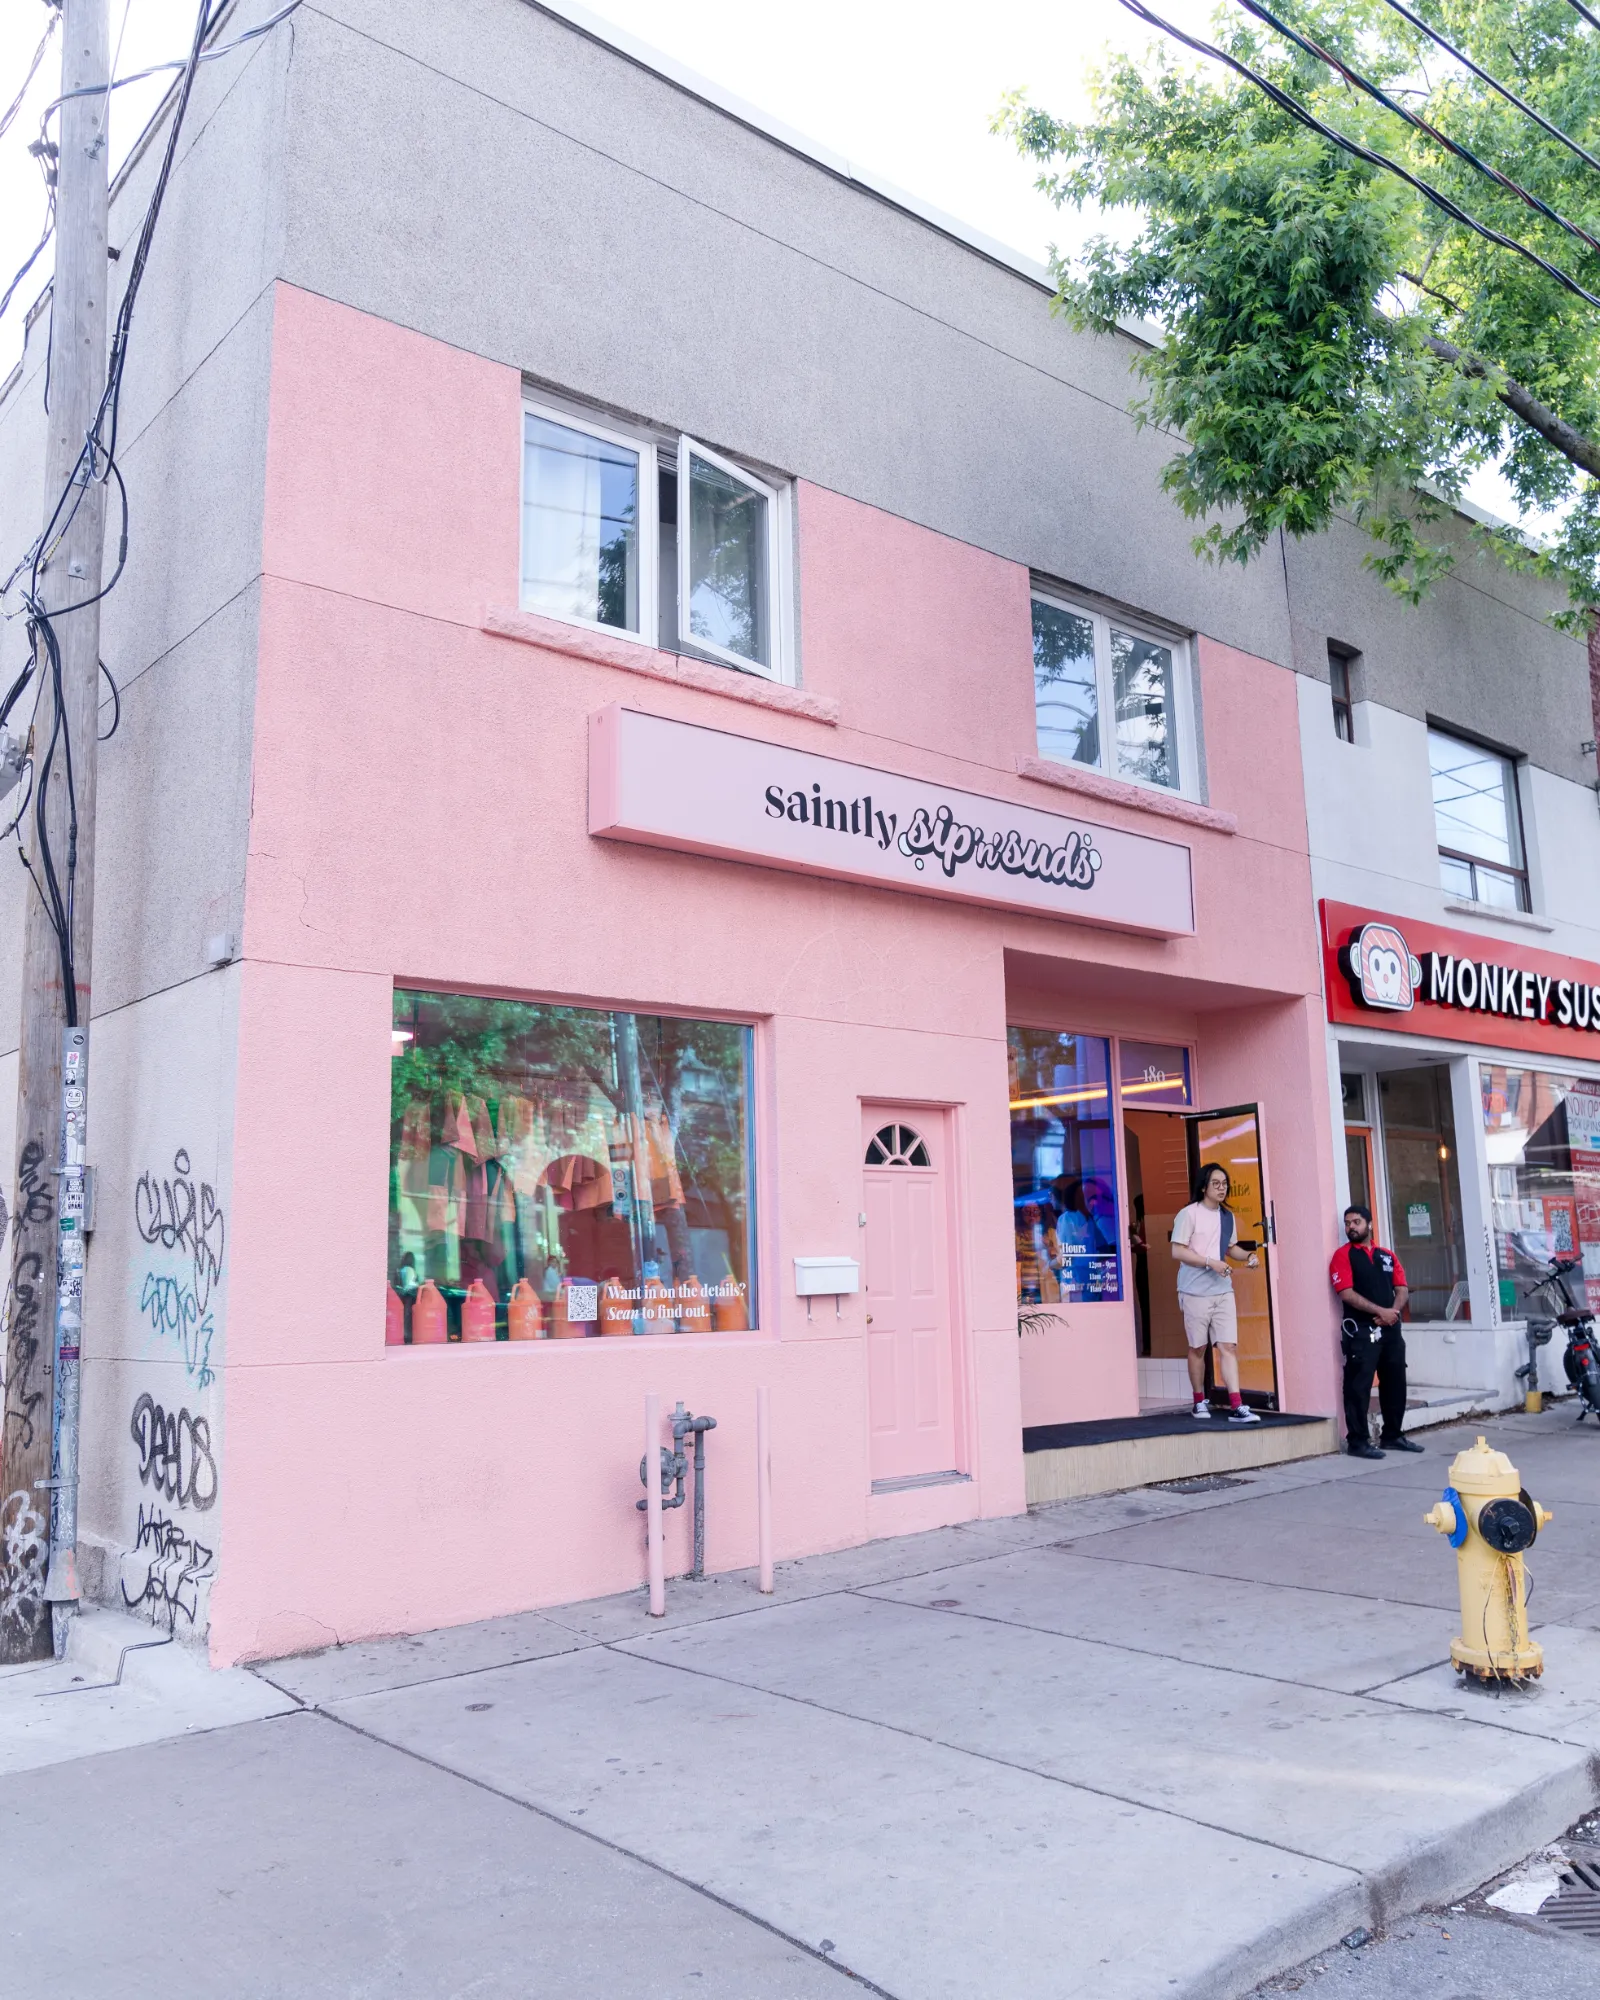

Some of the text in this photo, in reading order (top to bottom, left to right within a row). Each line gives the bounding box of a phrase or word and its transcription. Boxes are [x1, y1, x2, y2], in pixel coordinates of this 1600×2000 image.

[764, 783, 897, 850] saintly
[1430, 951, 1600, 1032] MONKEY SUS
[1143, 1065, 1165, 1082] 180
[1566, 1096, 1600, 1119] NOW OP
[1409, 1205, 1427, 1215] PASS
[1062, 1243, 1086, 1253] Hours
[1062, 1257, 1072, 1267] Fri
[1088, 1261, 1102, 1270] 12pm
[1105, 1260, 1116, 1270] 9pm
[1062, 1270, 1073, 1279] Sat
[1105, 1272, 1117, 1281] 9pm
[607, 1283, 747, 1300] Want in on the details?
[607, 1304, 709, 1321] Scan to find out.
